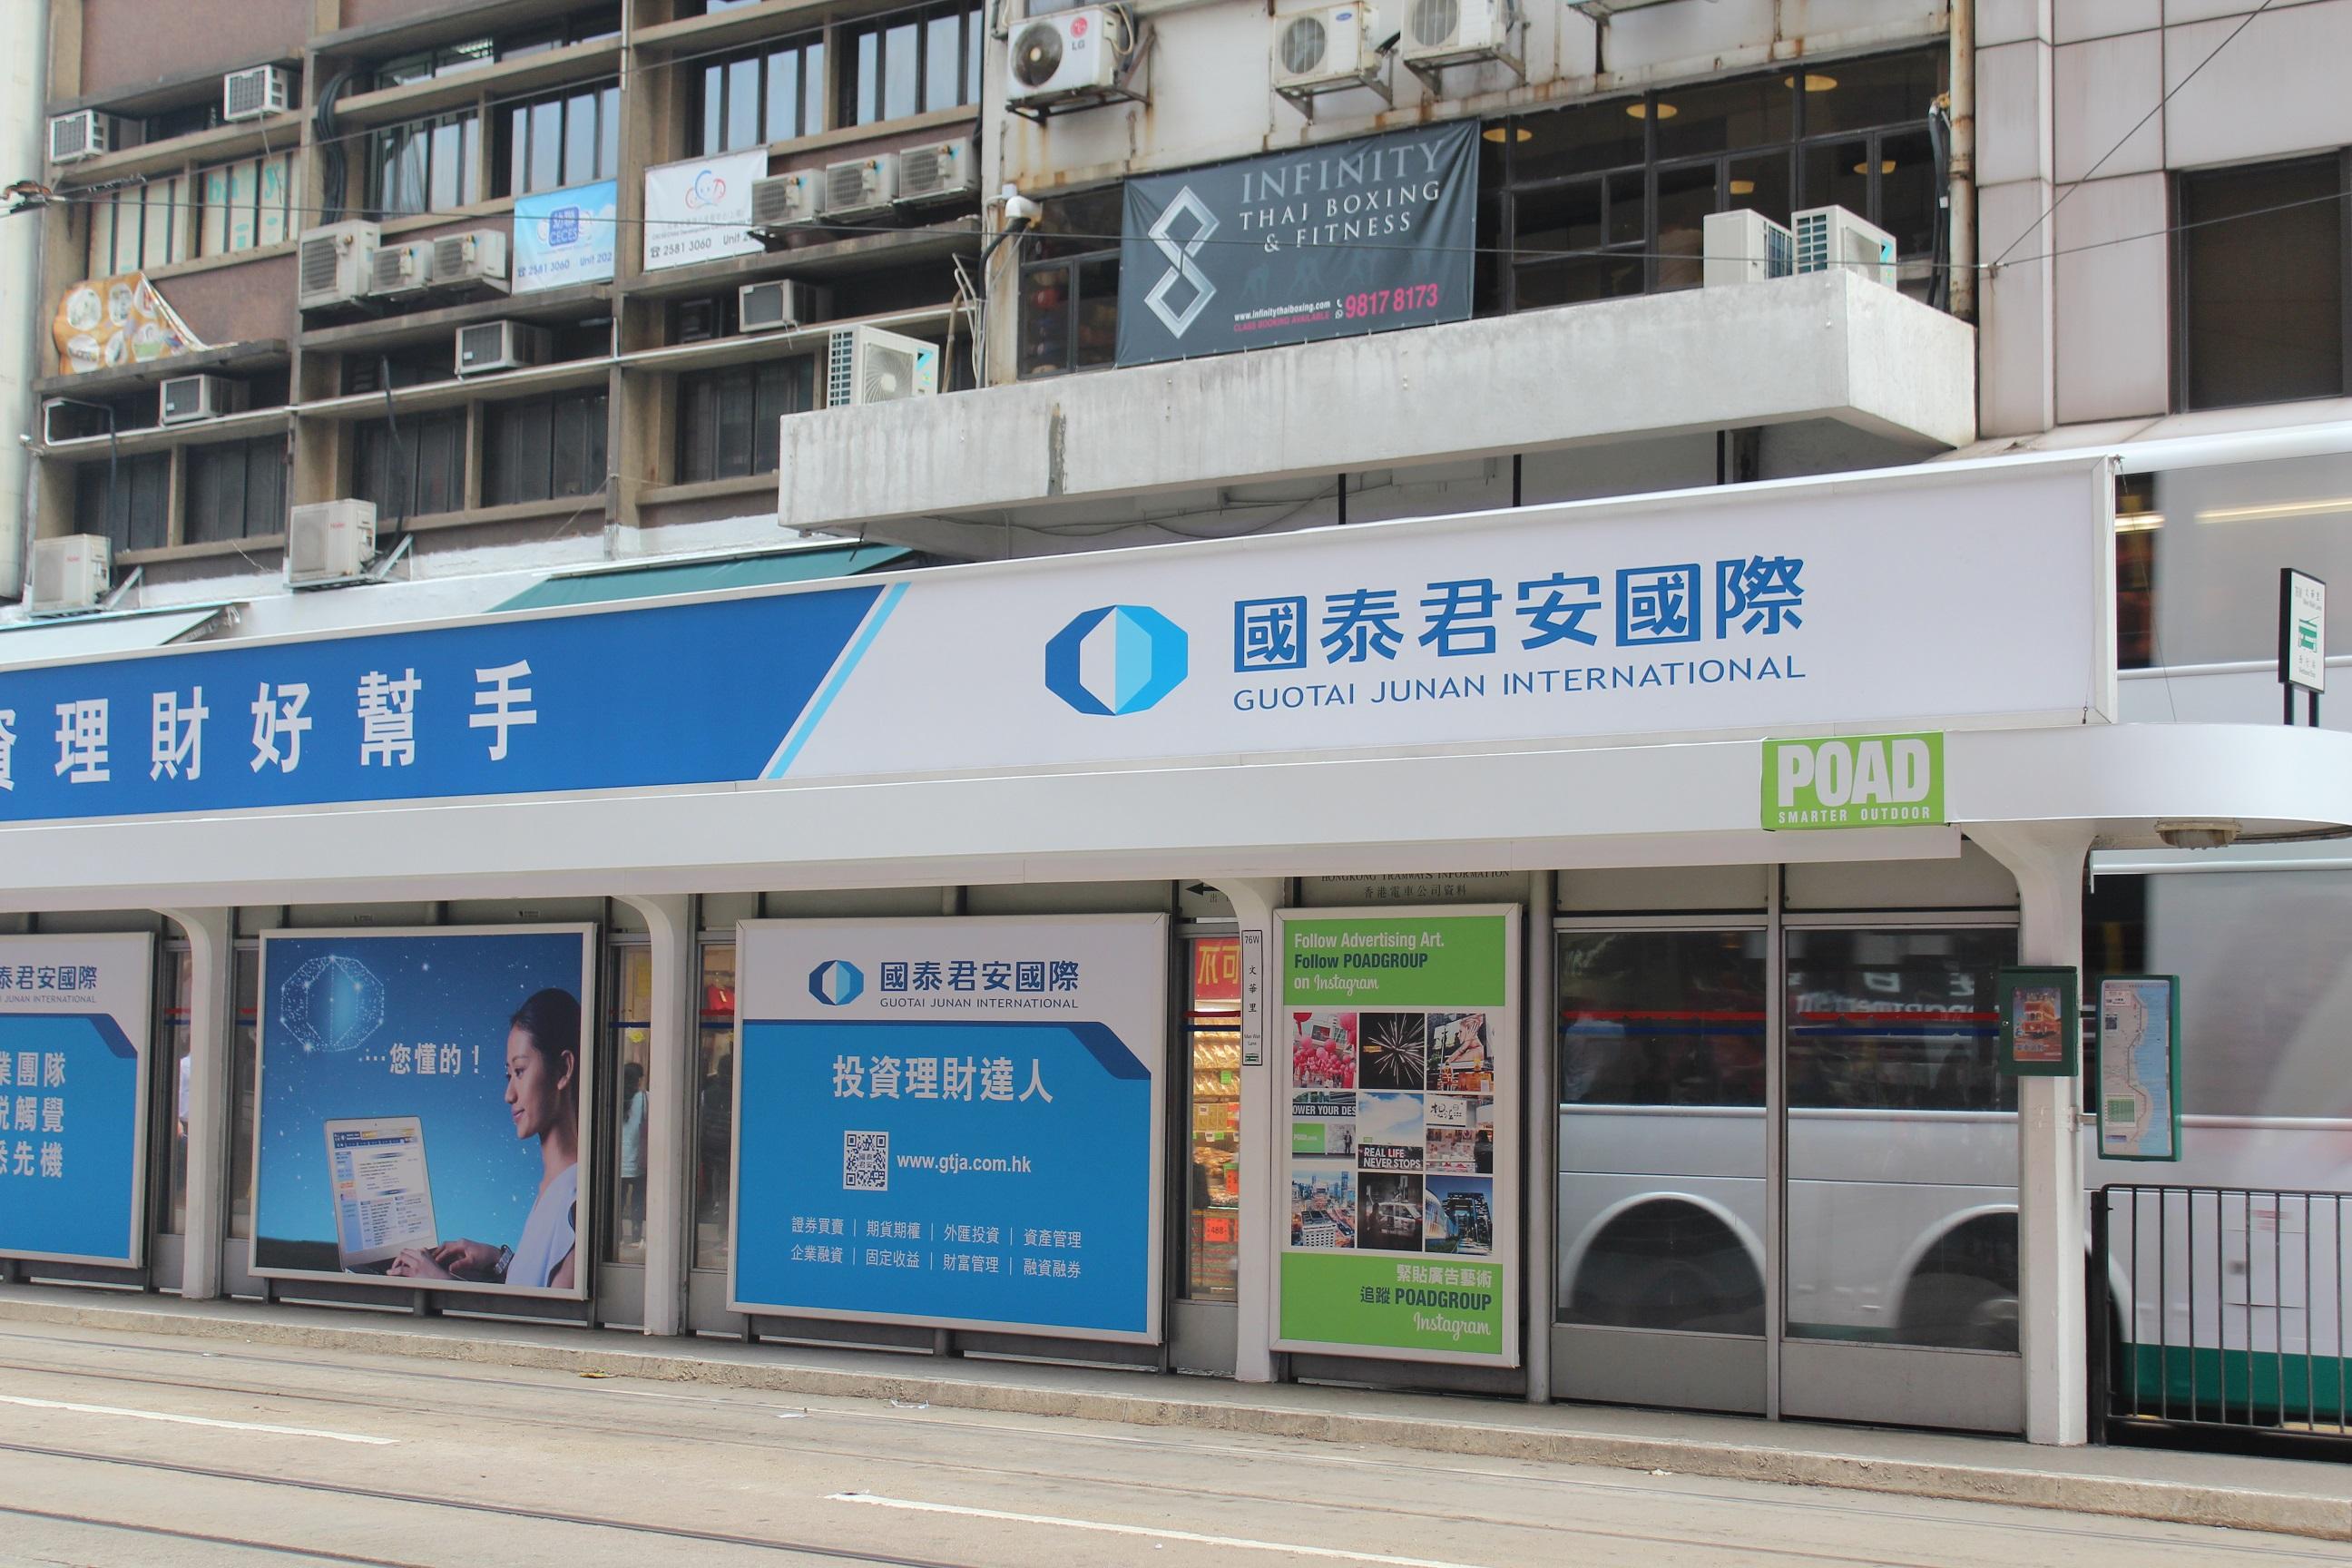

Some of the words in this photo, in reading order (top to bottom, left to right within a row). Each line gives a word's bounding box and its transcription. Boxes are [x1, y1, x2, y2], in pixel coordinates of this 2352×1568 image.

[1072, 39, 1085, 51] LG
[1240, 139, 1445, 204] INFINITY
[1240, 202, 1308, 230] THAI
[1327, 181, 1439, 218] BOXING
[663, 241, 685, 256] 2581
[689, 237, 711, 252] 3060
[723, 231, 740, 246] Unit
[1264, 232, 1280, 253] &
[1296, 211, 1411, 248] FITNESS
[1234, 299, 1331, 322] www.infinitythaiboxing.com
[1345, 289, 1390, 319] 9817
[1393, 283, 1438, 312] 8173
[1291, 311, 1331, 326] AVAILABLE
[1234, 554, 1804, 673] 國泰君安國際
[1234, 683, 1354, 711] GUOTAI
[1371, 674, 1485, 704] JUNAN
[1504, 655, 1806, 696] INTERNATIONAL
[1778, 739, 1930, 807] POAD
[1779, 809, 1847, 824] SMARTER
[1861, 806, 1930, 821] OUTDOOR
[1245, 936, 1259, 945] 76W
[1294, 933, 1337, 949] Follow
[1341, 932, 1416, 950] Advertising
[1420, 931, 1445, 947] Art.
[1294, 954, 1338, 969] Follow
[1343, 953, 1428, 968] POADGROUP
[880, 960, 1079, 992] 國泰君安國際
[1294, 976, 1309, 990] on
[1314, 974, 1379, 996] Instagram
[4, 995, 31, 1004] JUNAN
[33, 995, 97, 1004] INTERNATIONAL
[880, 997, 926, 1008] GUOTAI
[930, 998, 971, 1008] JUNAN
[976, 998, 1079, 1009] INTERNATIONAL
[833, 1054, 1054, 1103] 投資理財達人
[1318, 1104, 1339, 1115] YOUR
[897, 1153, 1032, 1174] www.gtja.com.hk
[1364, 1147, 1386, 1158] REAL
[1387, 1148, 1405, 1158] LIFE
[1364, 1157, 1392, 1167] NEVER
[1393, 1159, 1421, 1169] STOPS
[791, 1215, 844, 1236] 證券買賣
[866, 1220, 921, 1240] 期貨期權
[944, 1223, 999, 1245] 外匯投資
[1024, 1228, 1082, 1249] 資產管理
[790, 1243, 843, 1264] 企業融資
[866, 1248, 920, 1269] 固定收益
[943, 1252, 999, 1274] 財富管理
[1024, 1257, 1082, 1279] 融資融券
[1396, 1263, 1493, 1289] 緊貼廣告藝術
[1360, 1286, 1390, 1305] 追蹤
[1395, 1288, 1492, 1311] POADGROUP
[1414, 1311, 1491, 1342] Instagram
